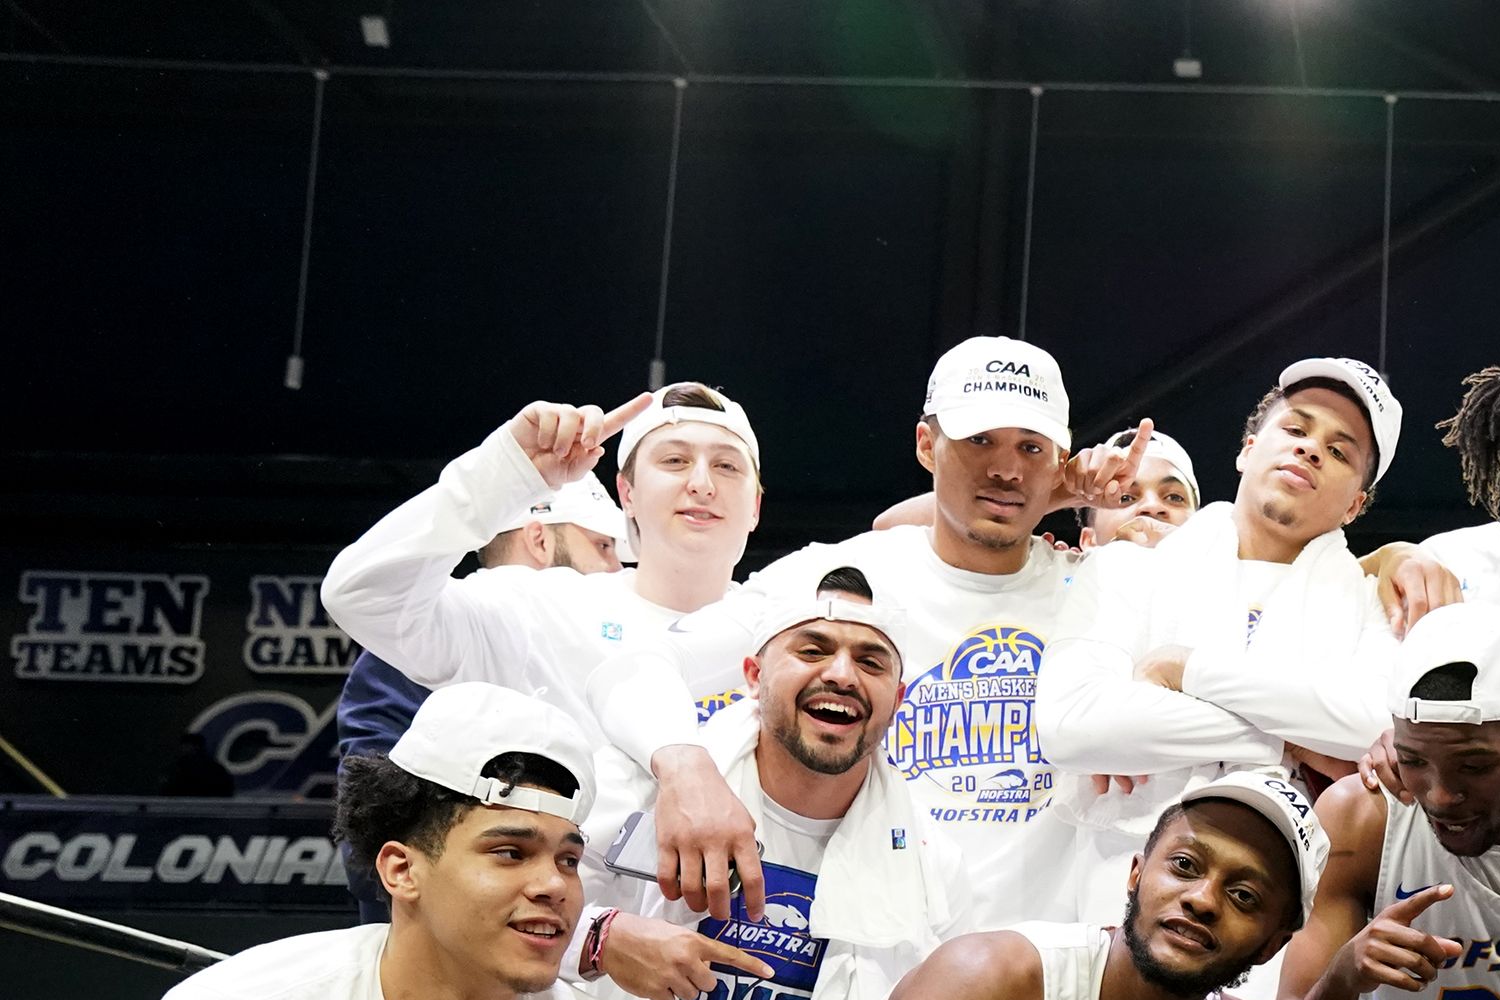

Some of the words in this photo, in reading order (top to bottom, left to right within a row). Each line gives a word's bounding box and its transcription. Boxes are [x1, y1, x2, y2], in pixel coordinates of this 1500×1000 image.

[985, 360, 1031, 378] CAA
[963, 381, 1049, 402] CHAMPIONS
[24, 574, 203, 637] TEN
[253, 578, 336, 630] NI
[16, 640, 200, 678] TEAMS
[250, 636, 356, 670] GAM
[968, 650, 1035, 674] CAA
[919, 681, 973, 704] MEN'S
[977, 678, 1036, 699] BASKE
[886, 700, 1040, 773] CHAMPI
[952, 776, 976, 792] 20
[1264, 780, 1311, 819] CAA
[725, 922, 817, 957] HOFSTRA
